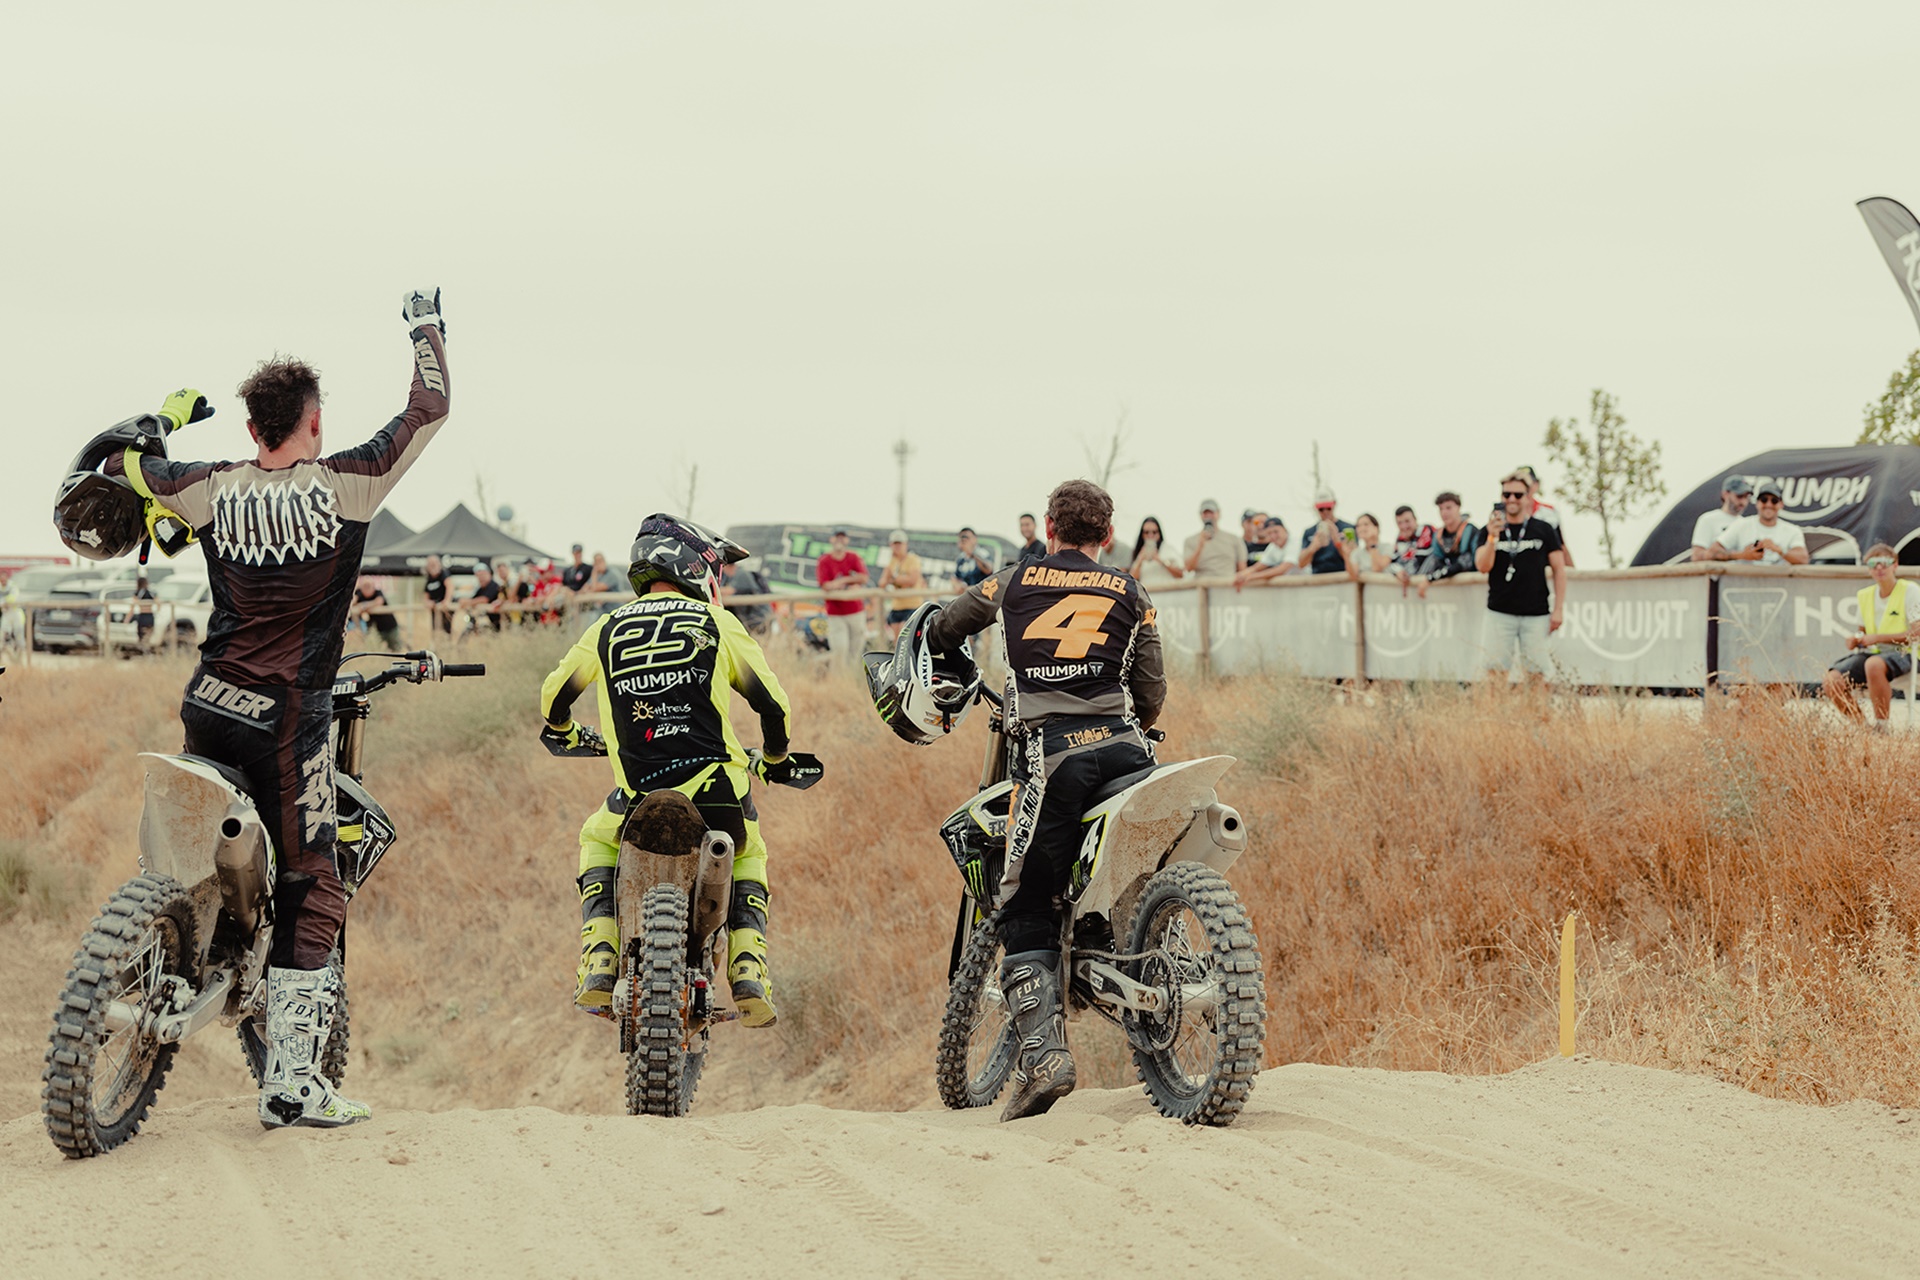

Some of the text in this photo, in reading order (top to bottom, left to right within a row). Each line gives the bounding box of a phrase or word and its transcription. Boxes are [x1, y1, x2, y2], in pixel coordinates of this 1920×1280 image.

[1021, 566, 1127, 595] CARMICHAEL
[614, 600, 708, 618] CERVANTES
[1022, 593, 1116, 659] 4
[607, 612, 709, 679] 25
[614, 669, 692, 697] TRIUMPH
[1025, 663, 1088, 682] TRIUMPH
[193, 674, 276, 719] DNGR
[1063, 725, 1113, 749] IMAGE
[1080, 815, 1104, 864] 4
[1016, 977, 1042, 999] FOX
[284, 1001, 317, 1019] FOX
